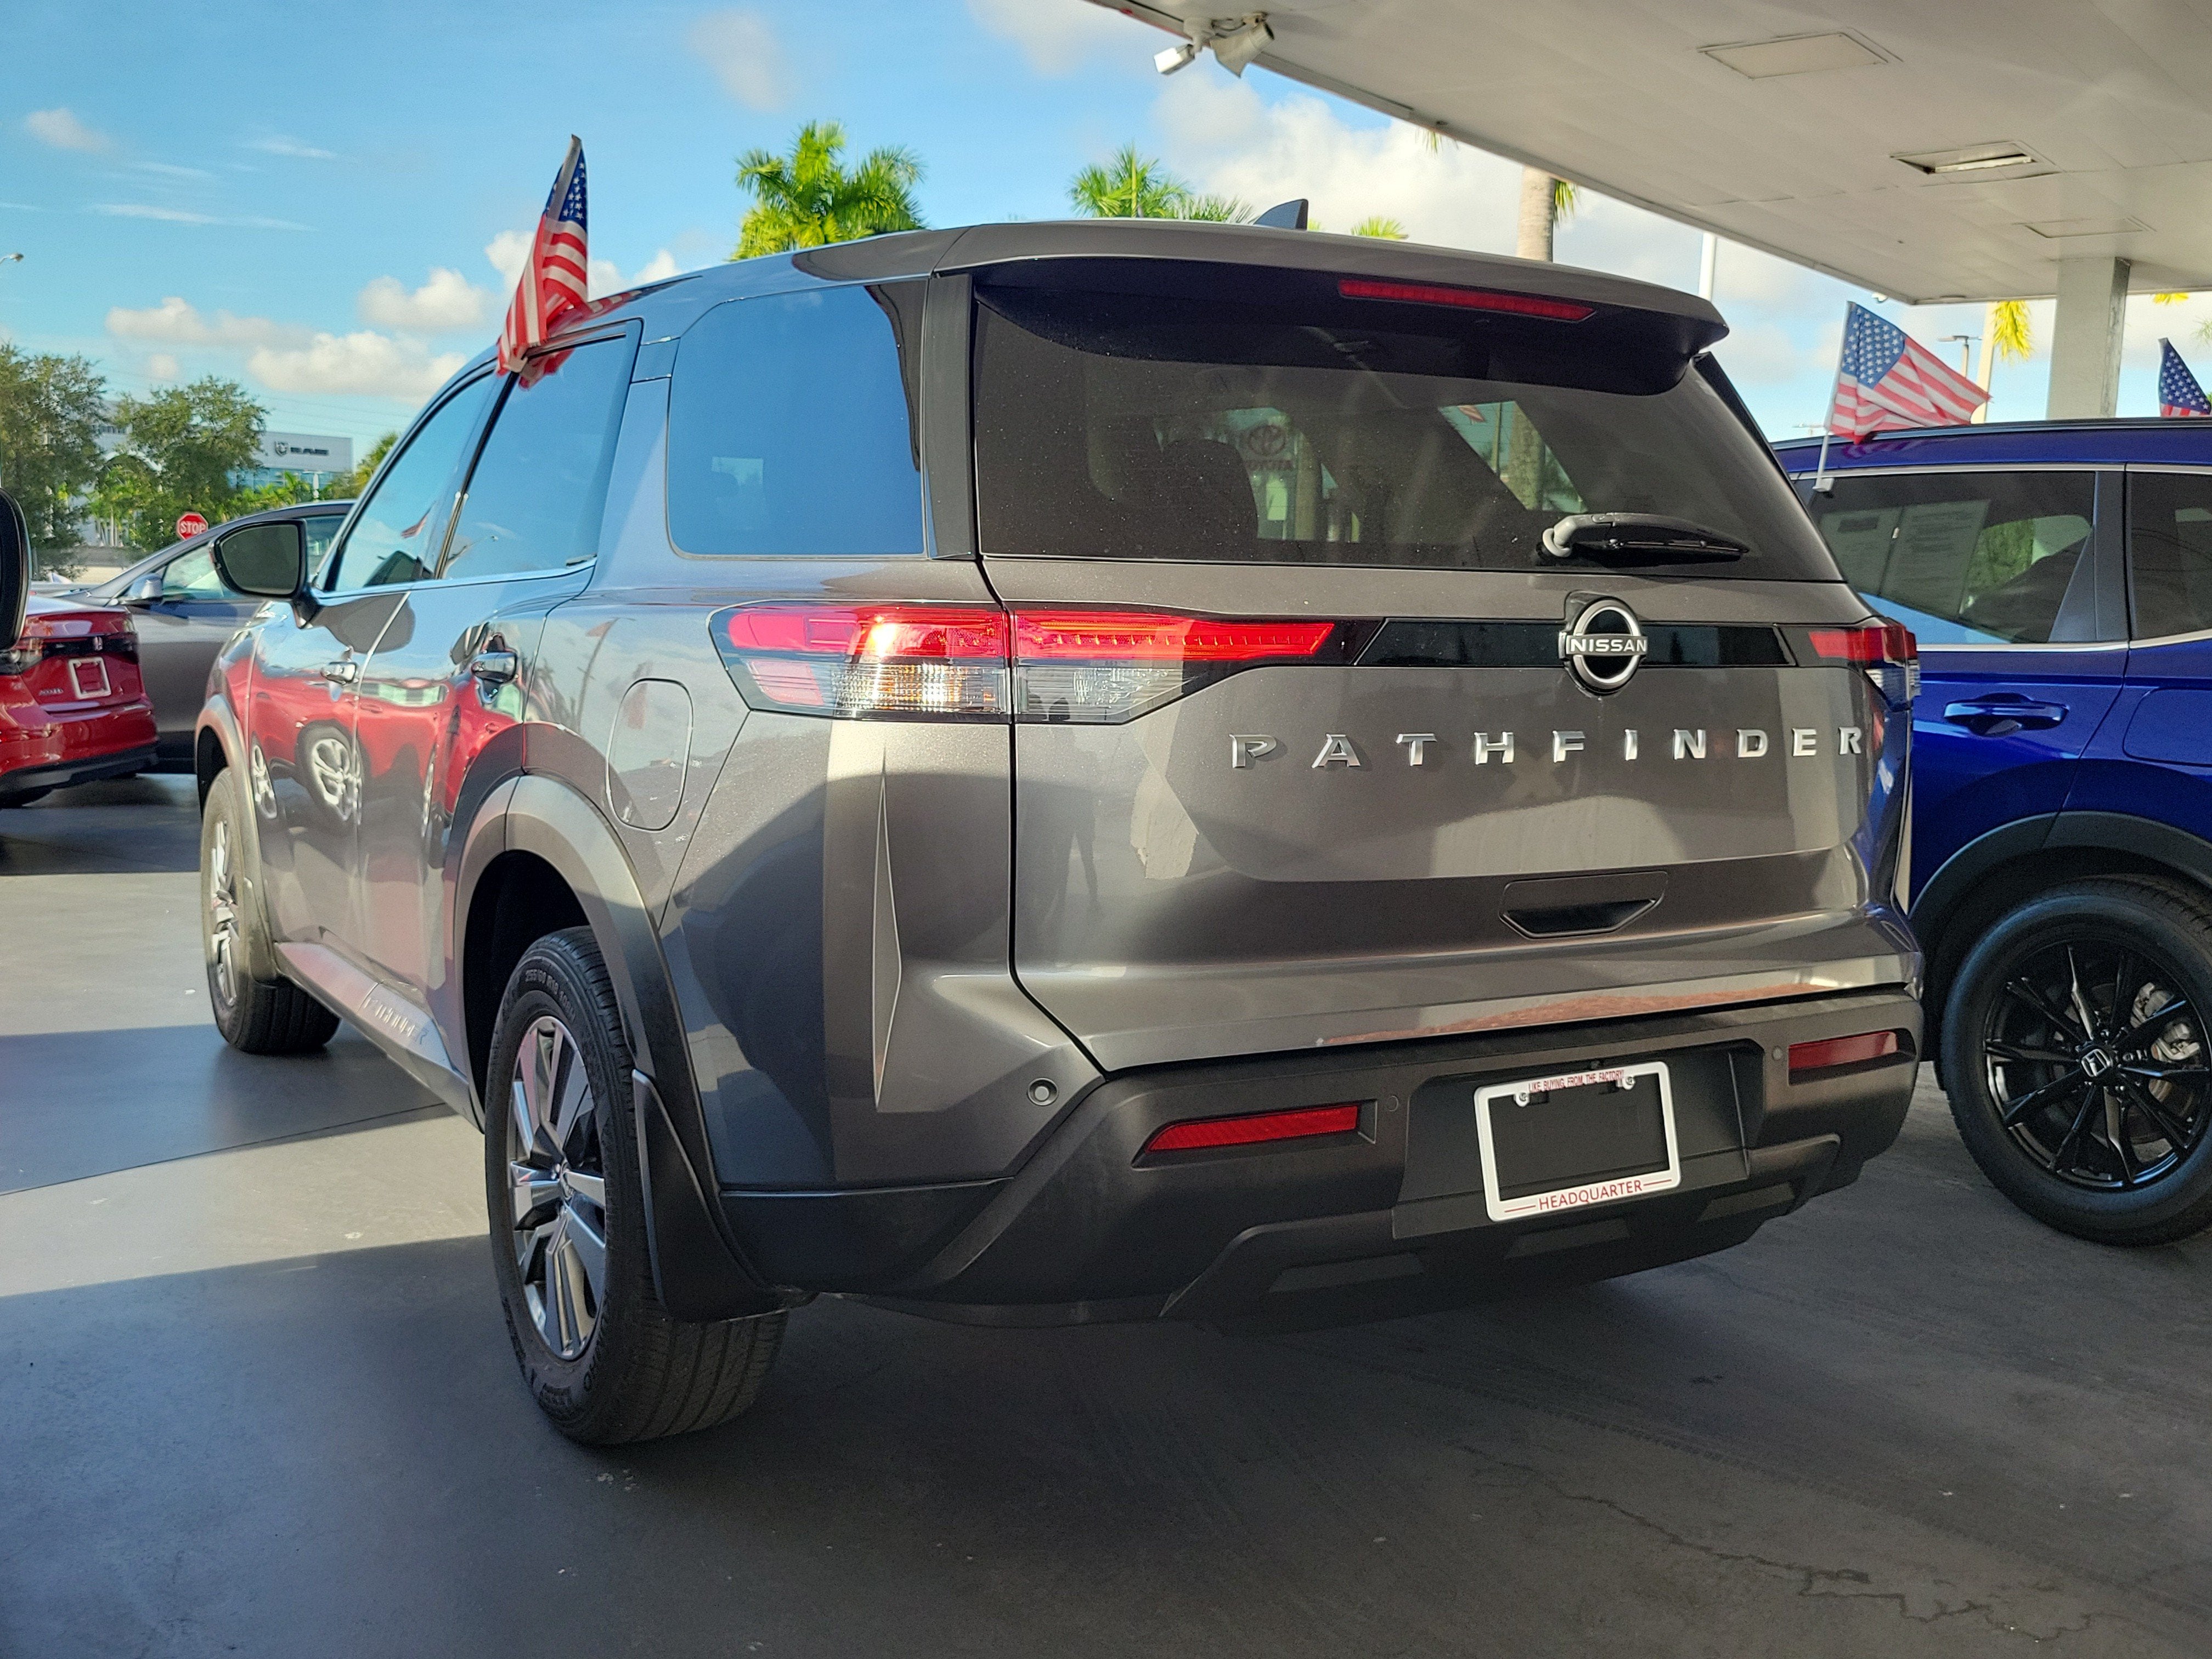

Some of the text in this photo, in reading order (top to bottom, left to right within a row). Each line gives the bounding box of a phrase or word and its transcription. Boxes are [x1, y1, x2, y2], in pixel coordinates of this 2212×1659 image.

[180, 521, 206, 534] STOP
[1570, 639, 1647, 652] NISSAN
[1228, 726, 1862, 768] PATHFINDER
[1528, 1081, 1541, 1093] LIKE
[1543, 1078, 1565, 1091] BUYING
[1567, 1075, 1583, 1087] FROM
[1585, 1073, 1596, 1084] THE
[1539, 1180, 1643, 1210] HEADQUARTER
